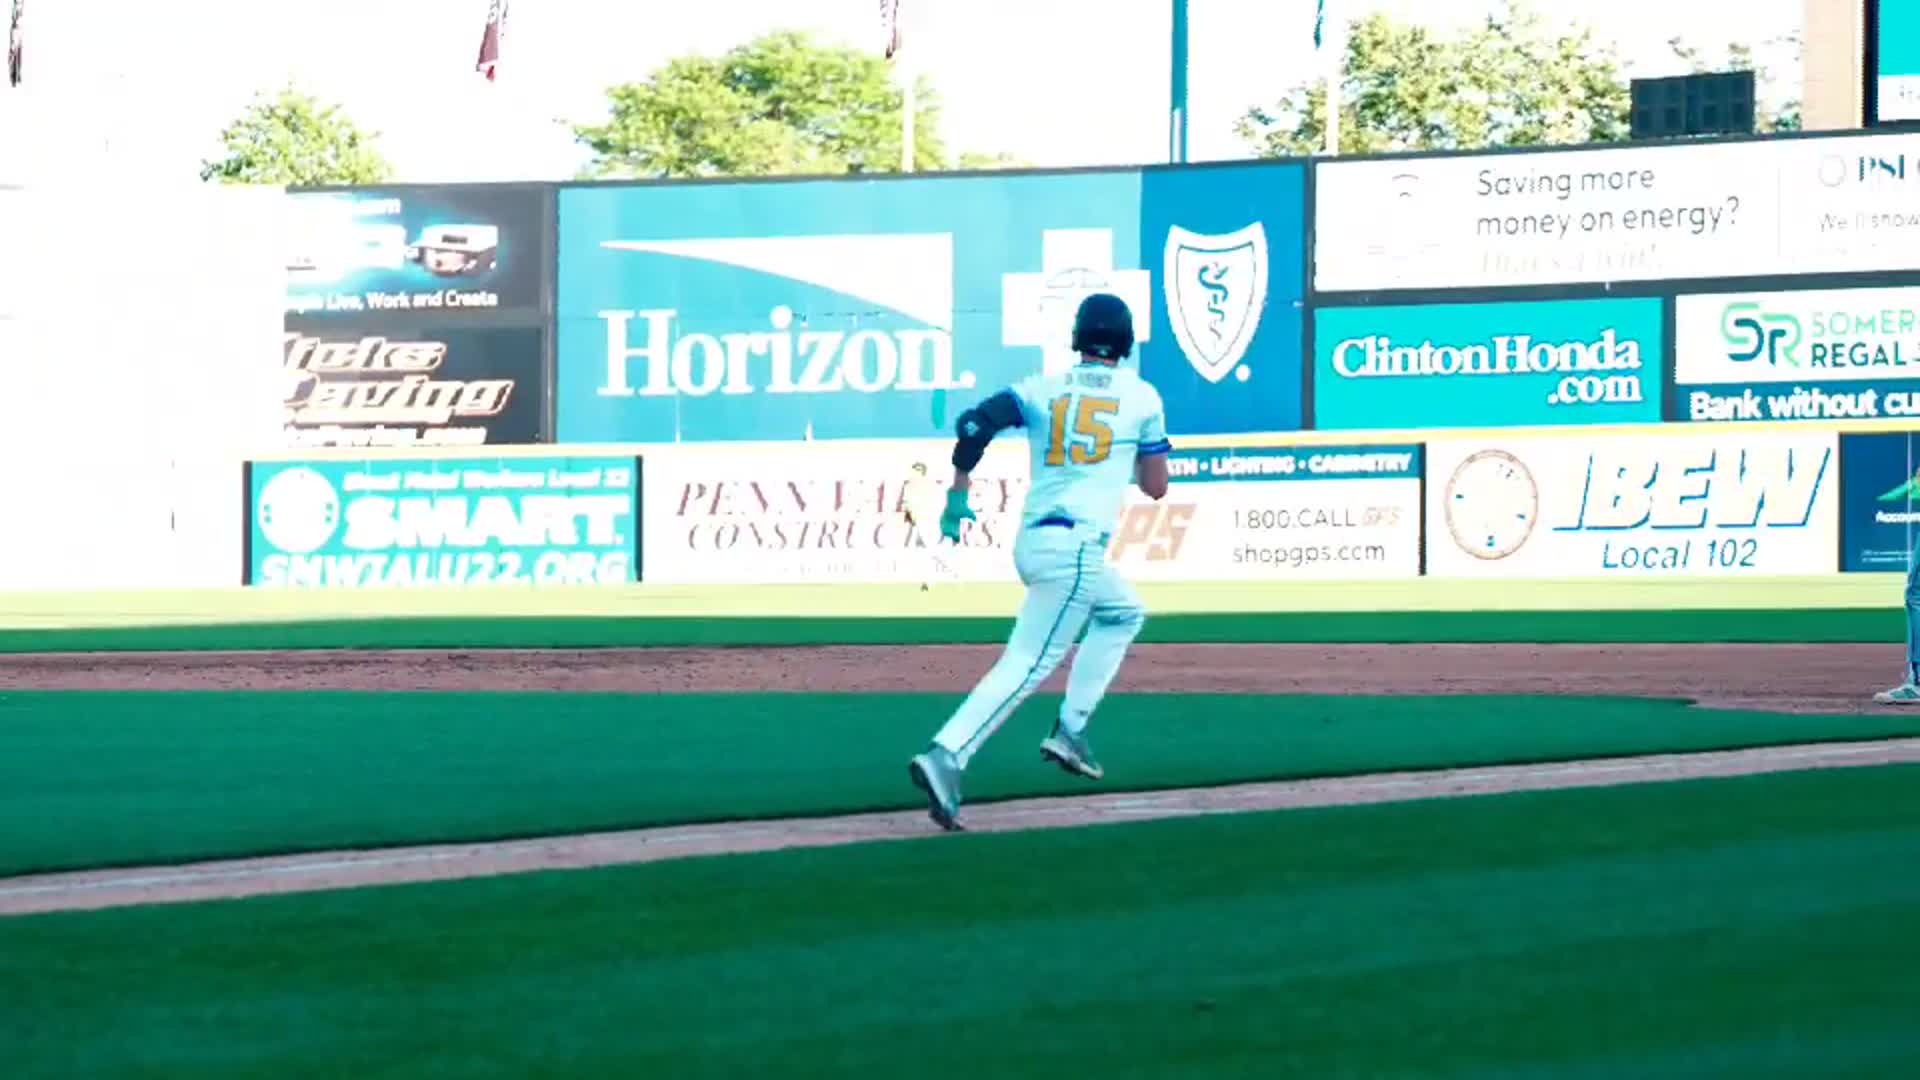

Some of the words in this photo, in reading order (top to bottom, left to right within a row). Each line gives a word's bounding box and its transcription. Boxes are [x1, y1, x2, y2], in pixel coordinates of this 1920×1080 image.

[1476, 169, 1570, 201] Saving
[1581, 167, 1656, 193] more
[1476, 210, 1570, 240] money
[1580, 208, 1616, 232] on
[1622, 196, 1741, 234] energy?
[367, 289, 410, 309] Work
[413, 289, 443, 307] and
[445, 288, 499, 306] Create
[1811, 307, 1920, 338] SOMER
[1811, 340, 1908, 368] REGAL
[1547, 373, 1642, 405] .com
[1689, 388, 1763, 421] Bank
[1767, 385, 1879, 419] without
[1045, 391, 1121, 467] 15
[1166, 457, 1198, 476] ATH
[676, 480, 816, 517] PENN
[1553, 446, 1832, 531] IBEW
[342, 495, 631, 548] SMART
[1602, 539, 1692, 570] Local
[1707, 537, 1759, 569] 102
